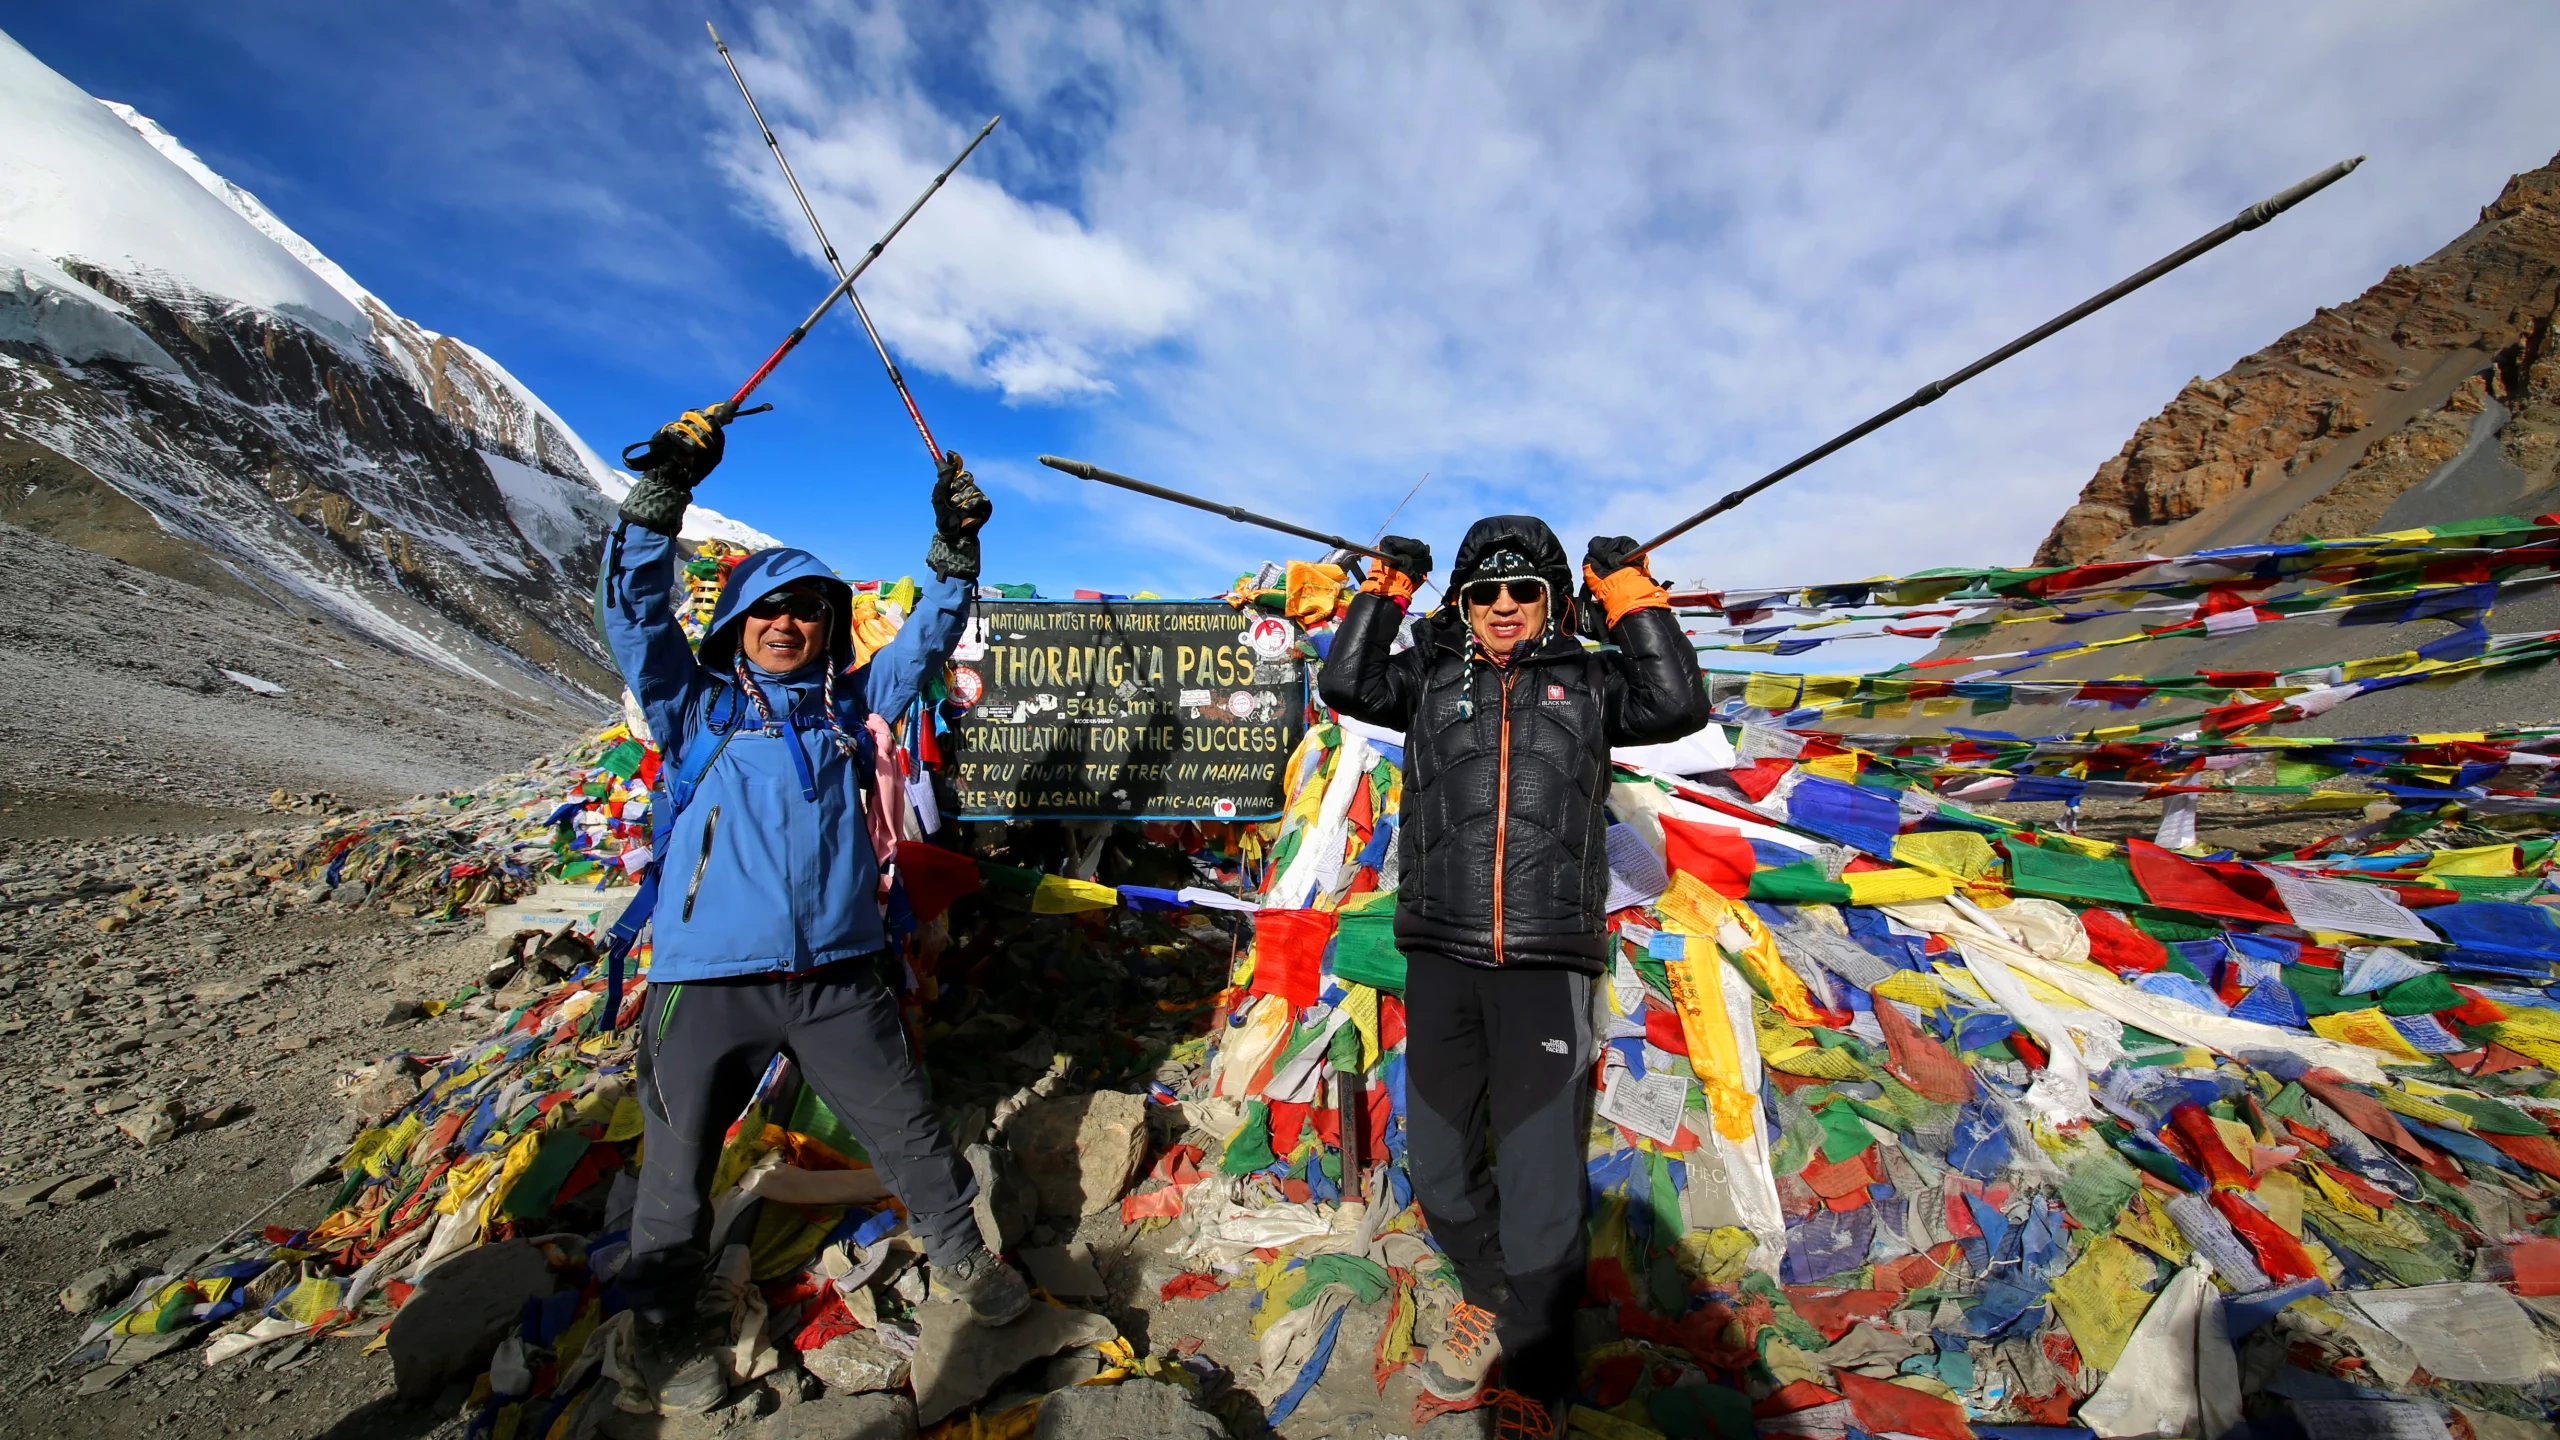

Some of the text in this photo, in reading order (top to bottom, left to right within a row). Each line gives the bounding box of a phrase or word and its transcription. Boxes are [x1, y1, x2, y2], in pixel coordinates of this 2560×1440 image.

[990, 613, 1246, 633] NATIONAL TRUST FOR NATURE CONSERVATION
[990, 645, 1255, 688] THORANG-LA PASS
[1066, 697, 1119, 717] 5416
[1090, 725, 1131, 753] FOR
[1134, 725, 1174, 751] THE
[982, 763, 1015, 783] YOU
[1021, 764, 1078, 782] ENJOY
[1085, 764, 1120, 782] THE
[1127, 763, 1173, 782] TREK
[1178, 763, 1199, 781] IN
[1202, 763, 1275, 782] MANANG
[957, 791, 987, 808] SEE
[993, 790, 1031, 808] YOU
[1037, 791, 1100, 808] AGAIN
[1541, 1041, 1560, 1049] NORTH
[1546, 1046, 1560, 1054] FACE
